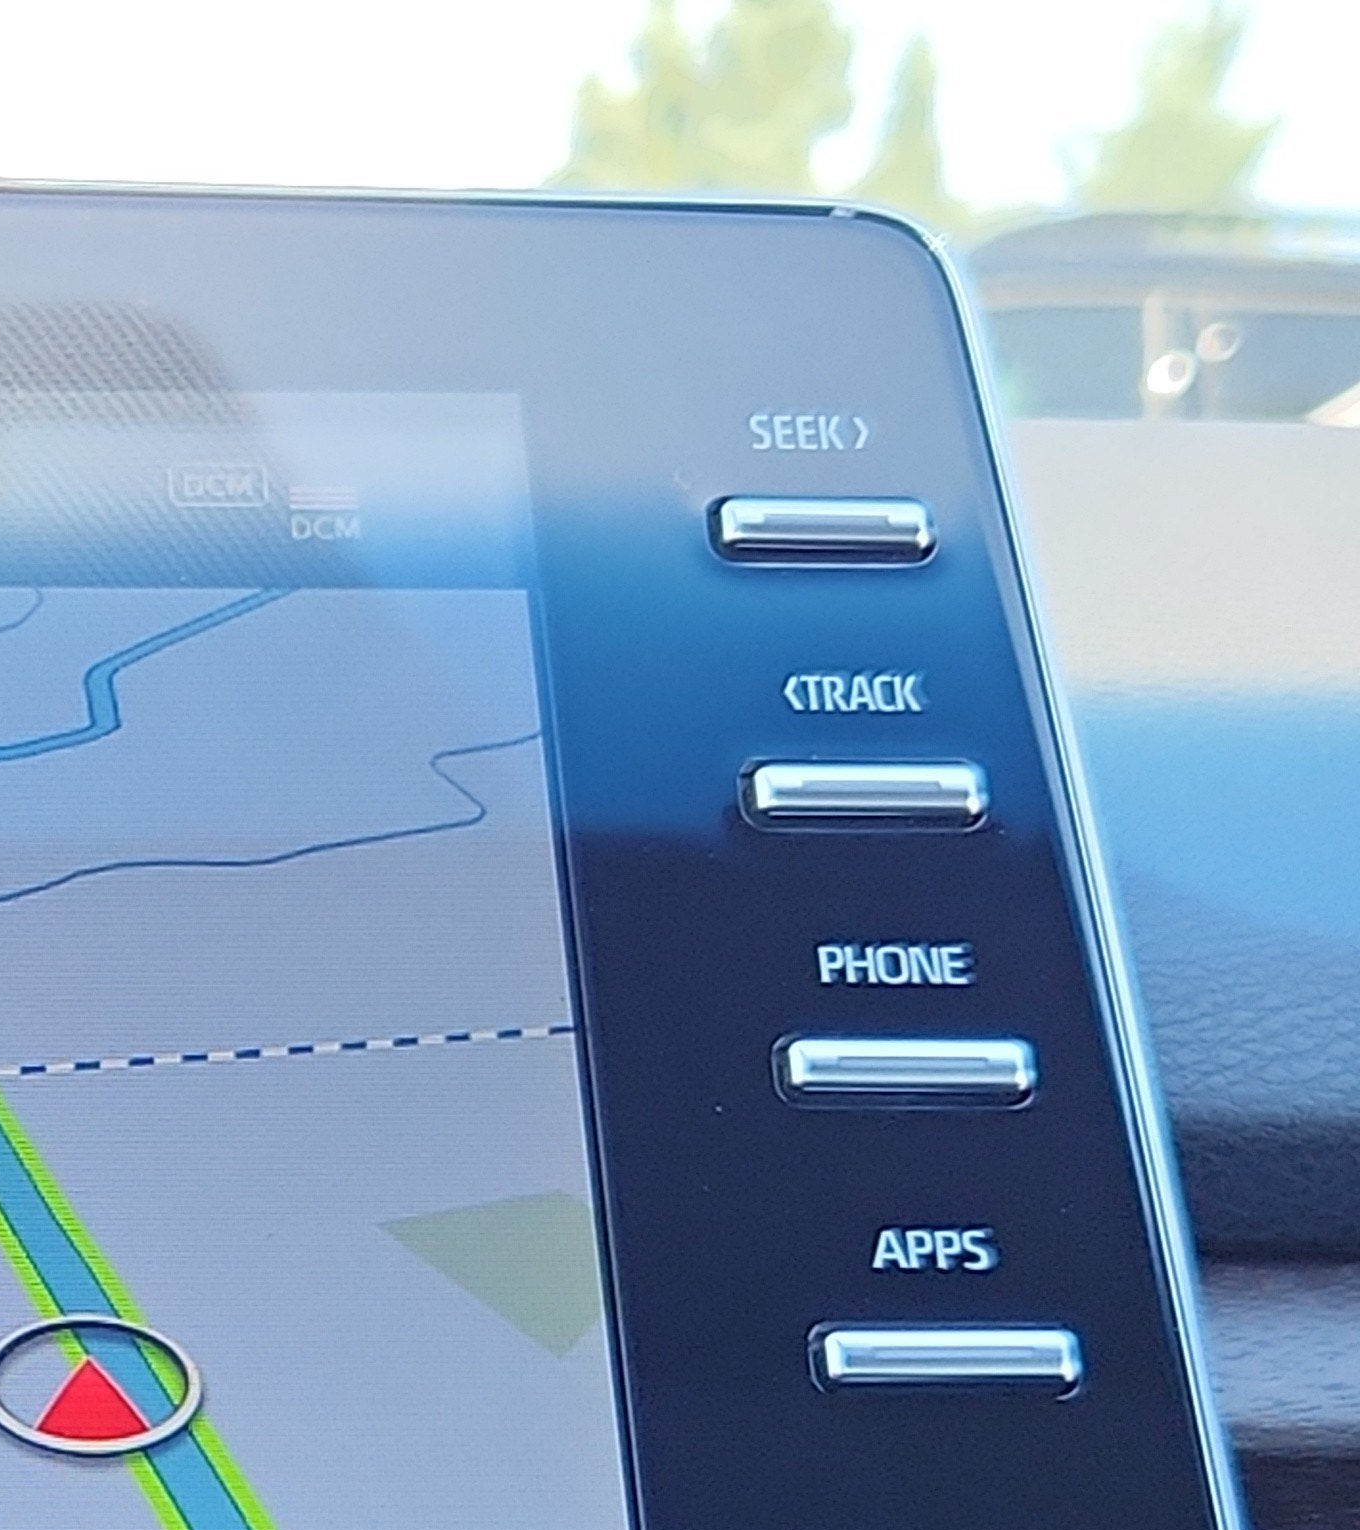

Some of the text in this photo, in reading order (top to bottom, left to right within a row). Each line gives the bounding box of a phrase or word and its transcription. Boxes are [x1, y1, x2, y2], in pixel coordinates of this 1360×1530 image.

[749, 414, 843, 450] SEEK
[291, 514, 361, 541] DCM
[799, 675, 922, 713] TRACK
[817, 945, 974, 987] PHONE
[872, 1229, 998, 1271] APPS
